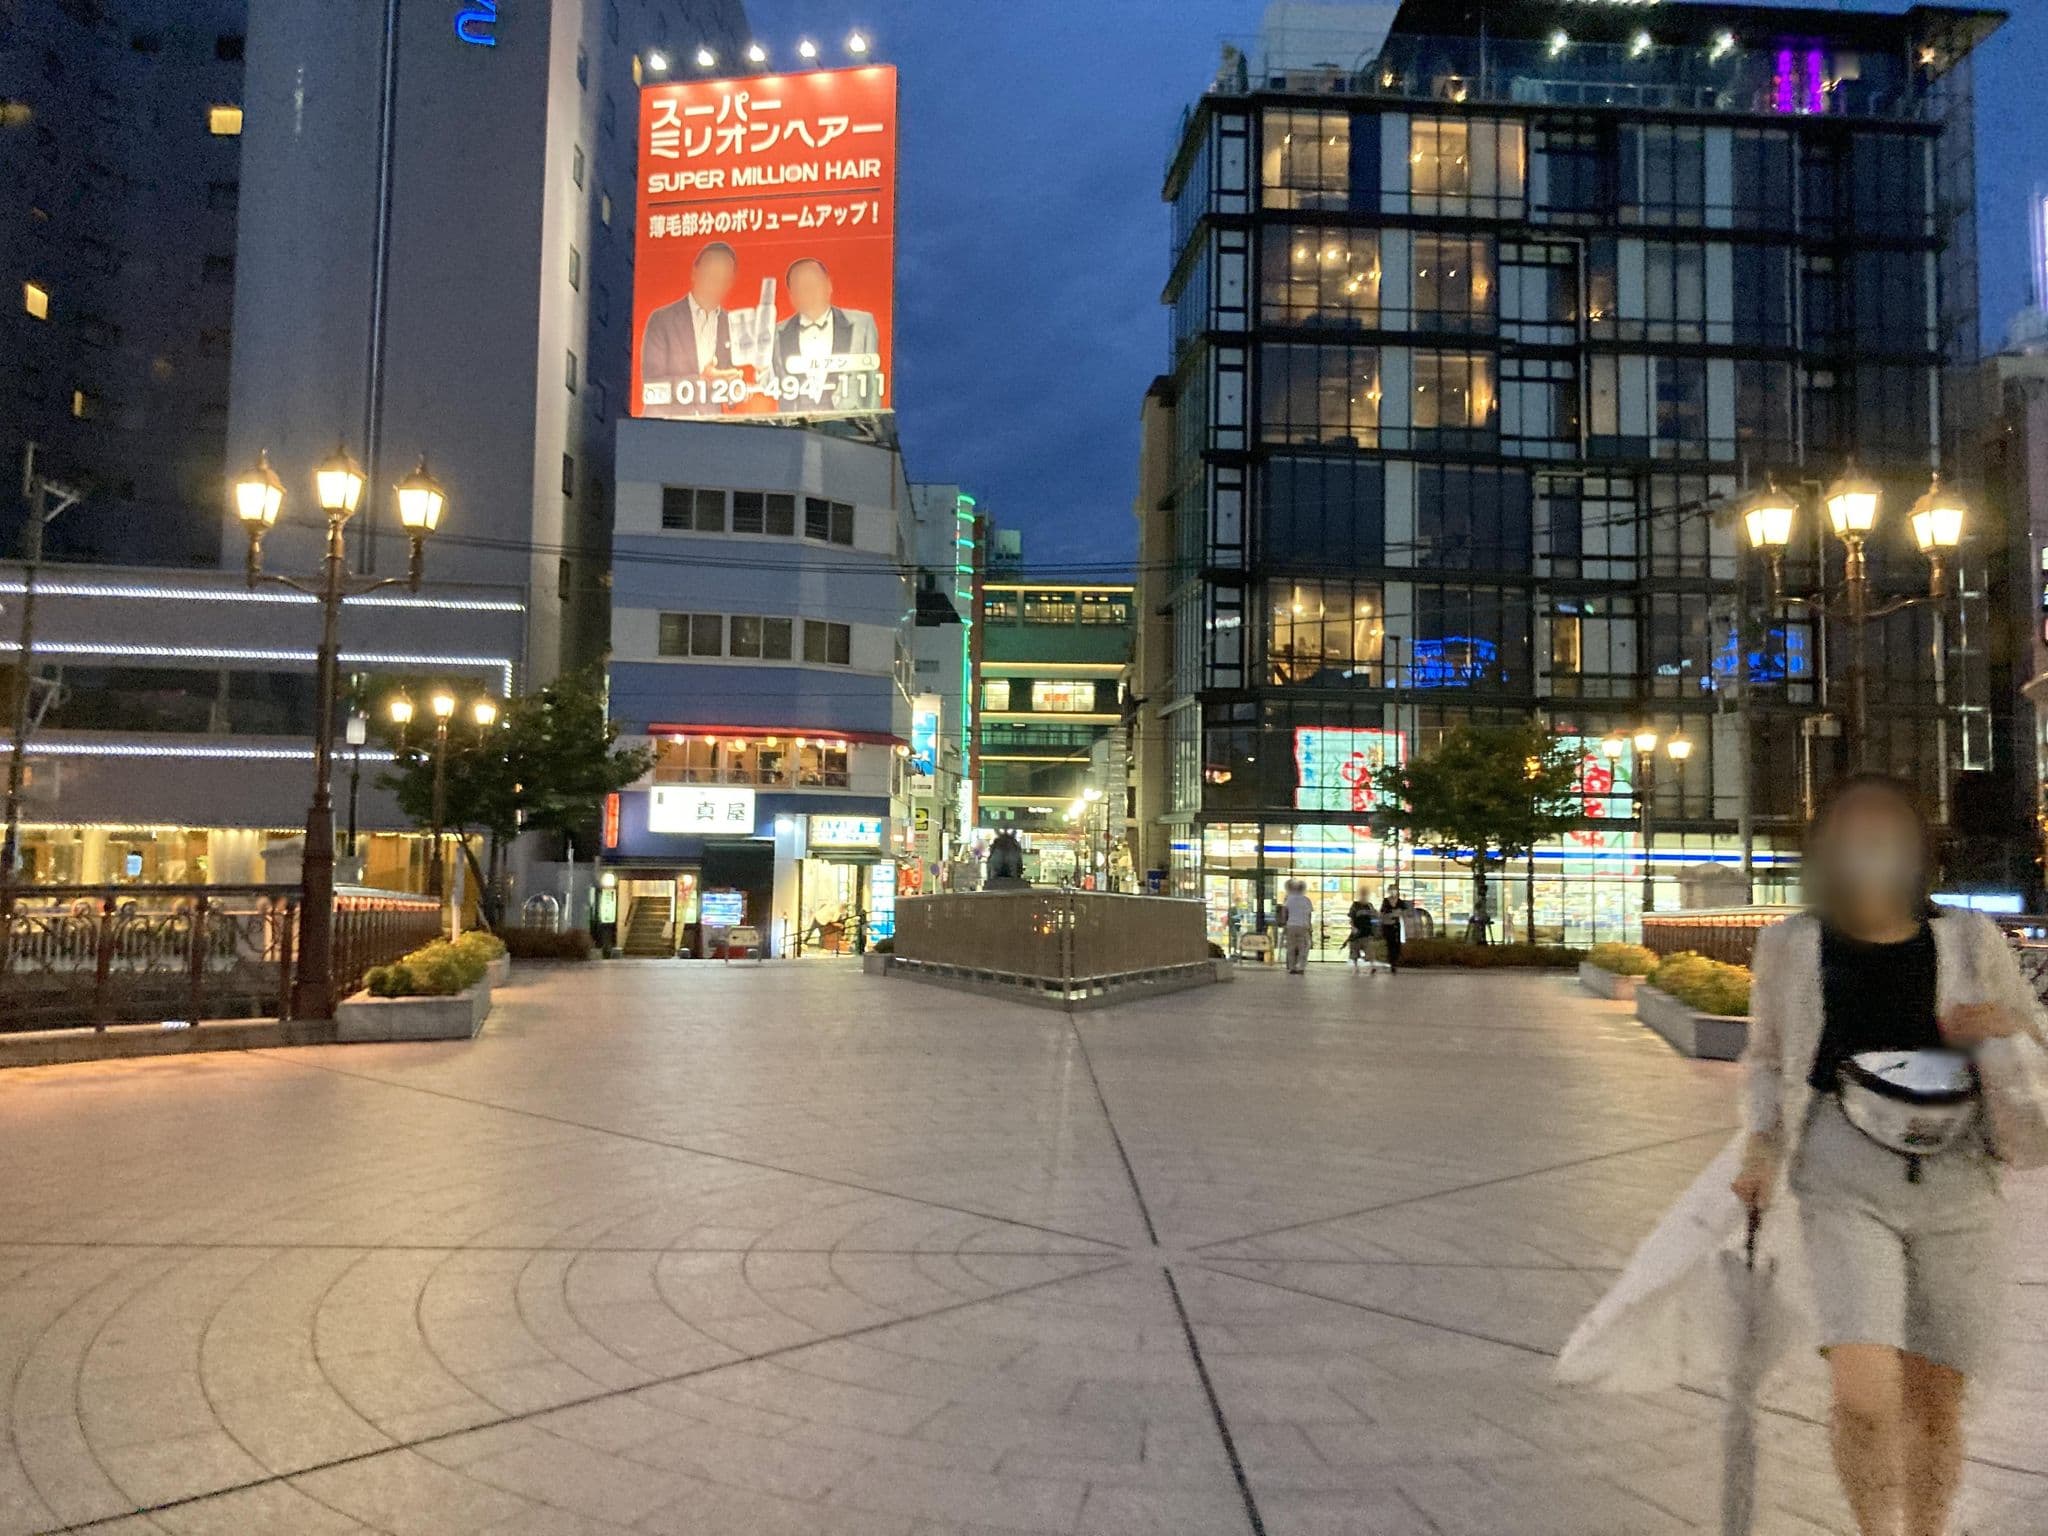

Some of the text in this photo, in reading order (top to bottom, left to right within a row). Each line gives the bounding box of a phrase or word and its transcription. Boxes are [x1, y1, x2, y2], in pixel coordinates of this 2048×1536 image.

[651, 91, 781, 131] スーパー
[650, 115, 884, 159] ミリオンヘアー
[648, 159, 880, 194] SUPER MILLION HAIR
